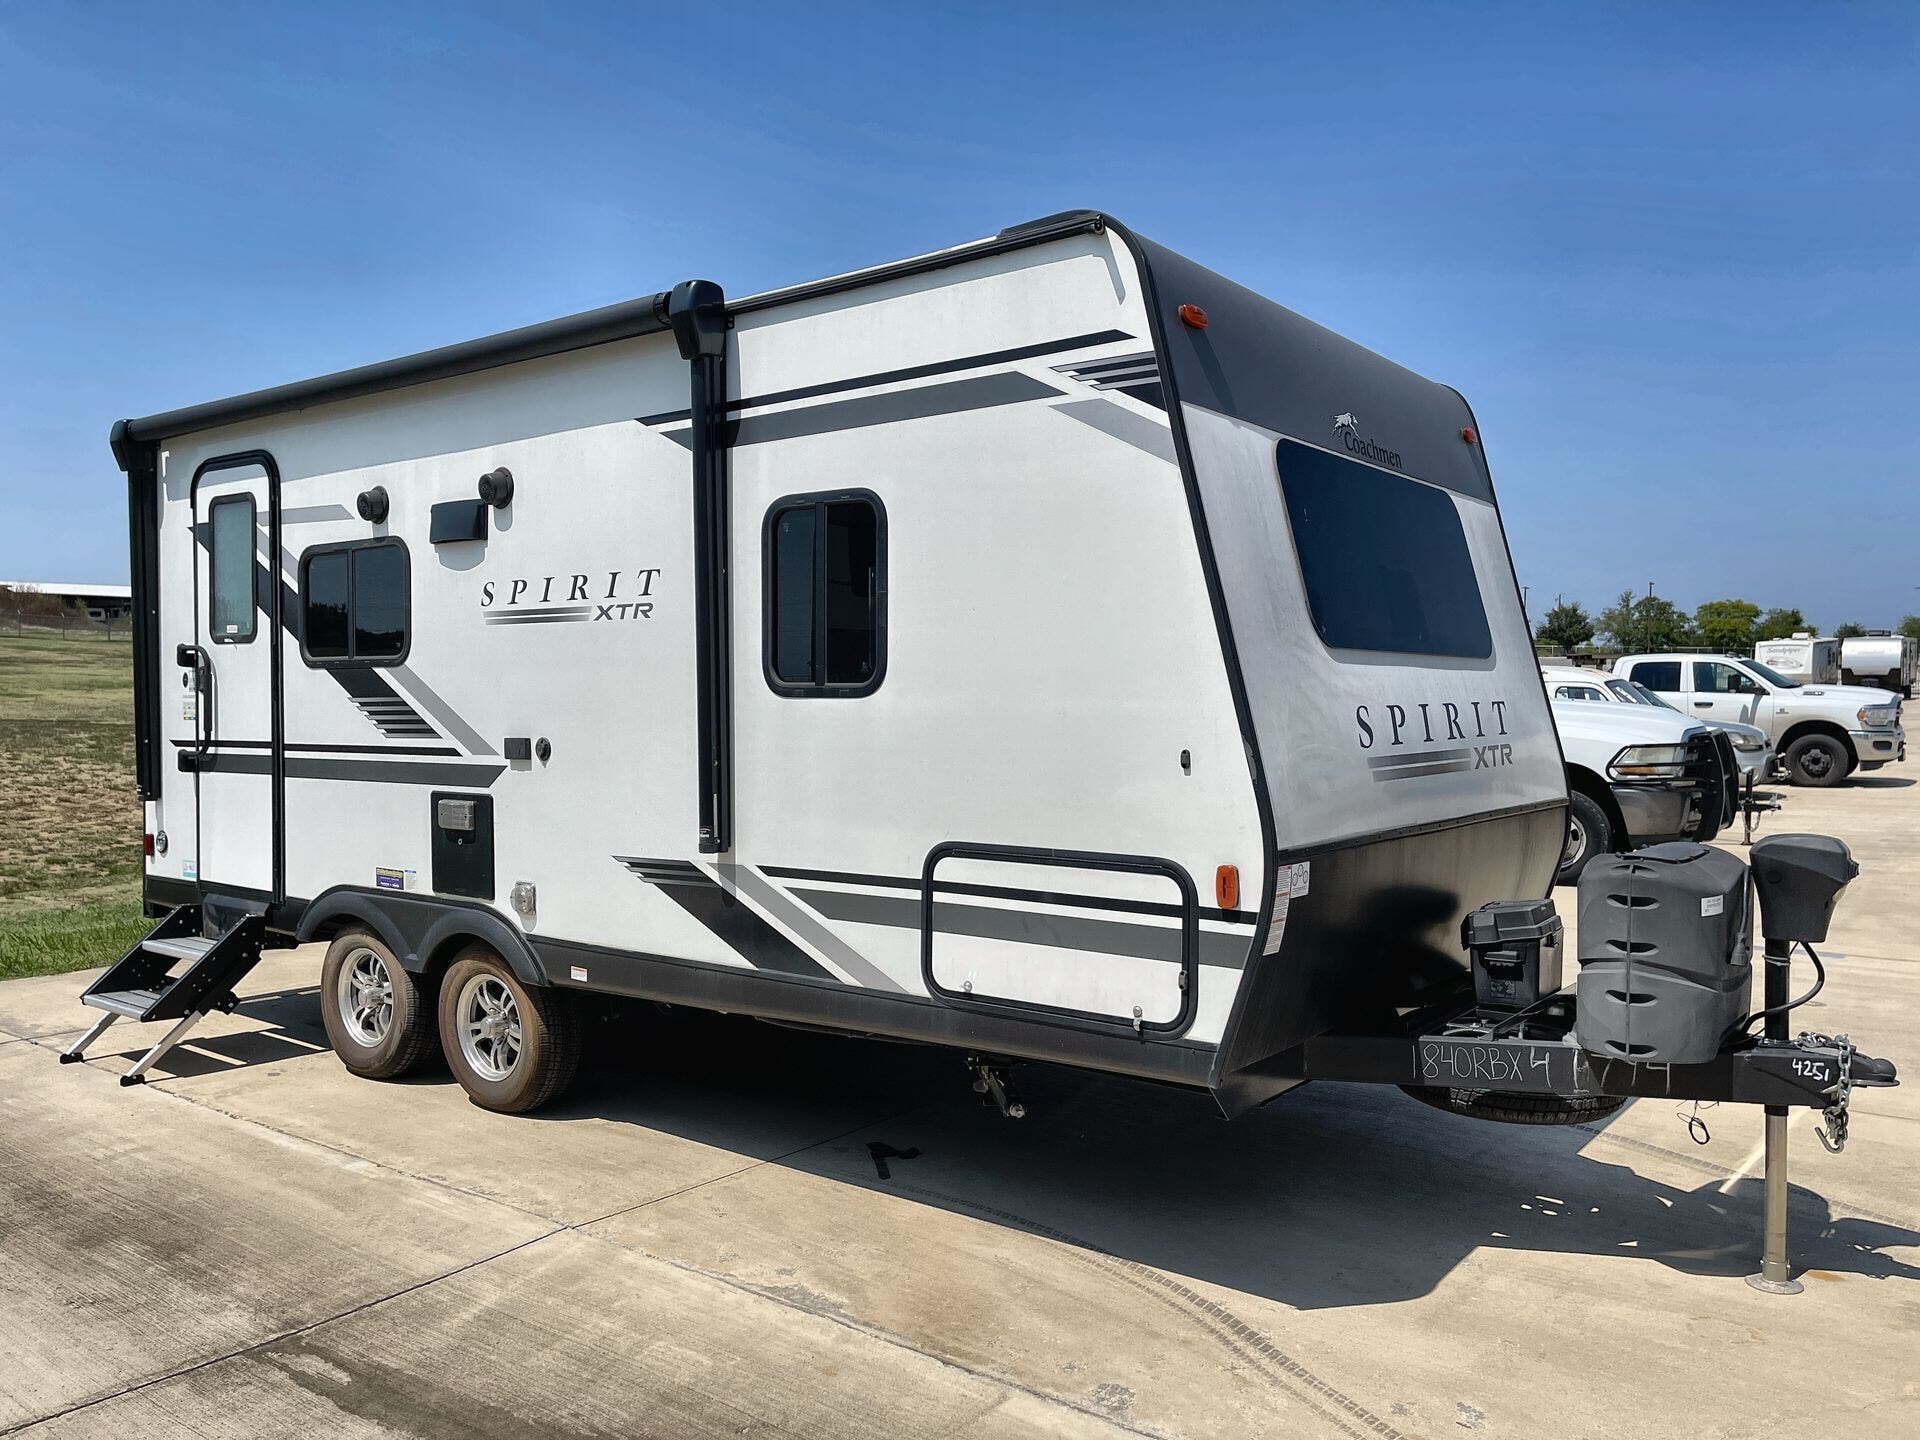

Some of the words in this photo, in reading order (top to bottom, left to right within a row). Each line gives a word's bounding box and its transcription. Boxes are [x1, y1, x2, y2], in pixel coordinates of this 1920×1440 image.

[1344, 431, 1403, 468] Coachmen
[480, 568, 661, 607] SPIRIT
[593, 602, 654, 622] XTR
[1356, 700, 1508, 749] SPIRIT
[1473, 743, 1514, 769] XTR
[1792, 1058, 1830, 1082] 4251
